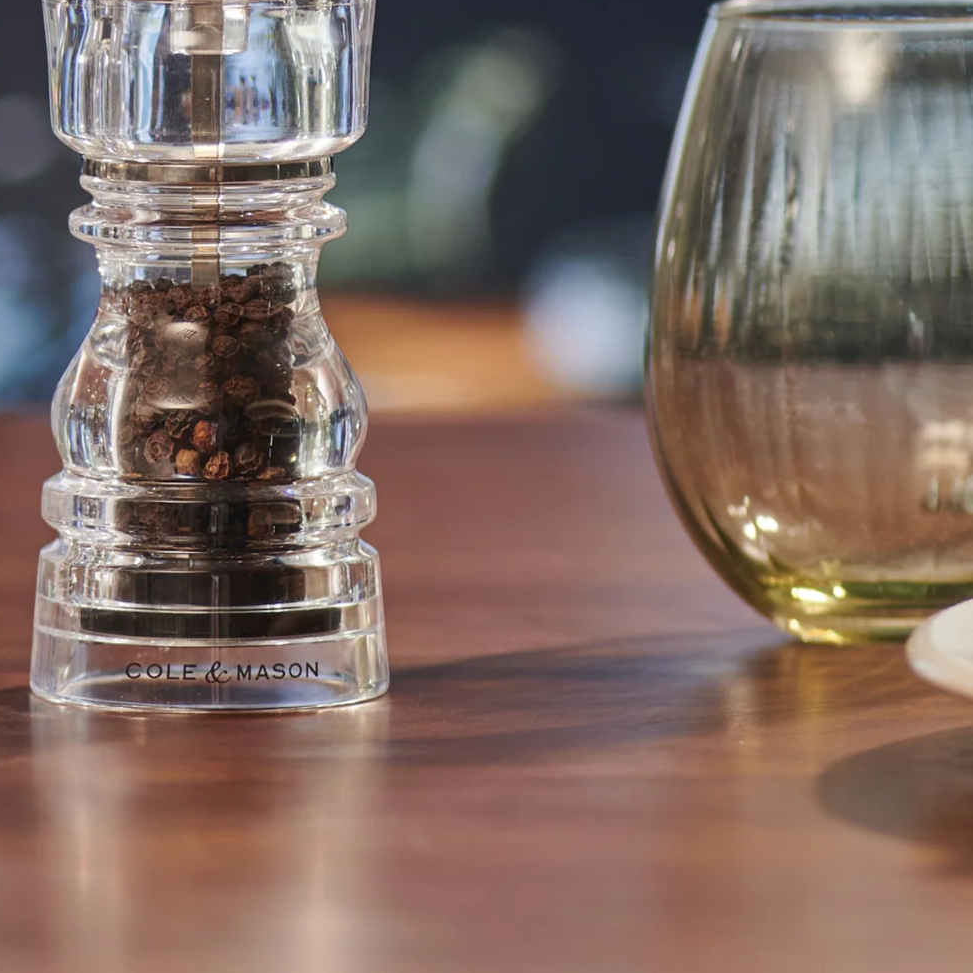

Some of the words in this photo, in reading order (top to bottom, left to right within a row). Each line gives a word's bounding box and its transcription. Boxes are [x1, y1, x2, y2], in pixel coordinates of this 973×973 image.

[126, 662, 196, 680] COLE
[205, 661, 231, 684] &
[236, 661, 319, 680] MASON
